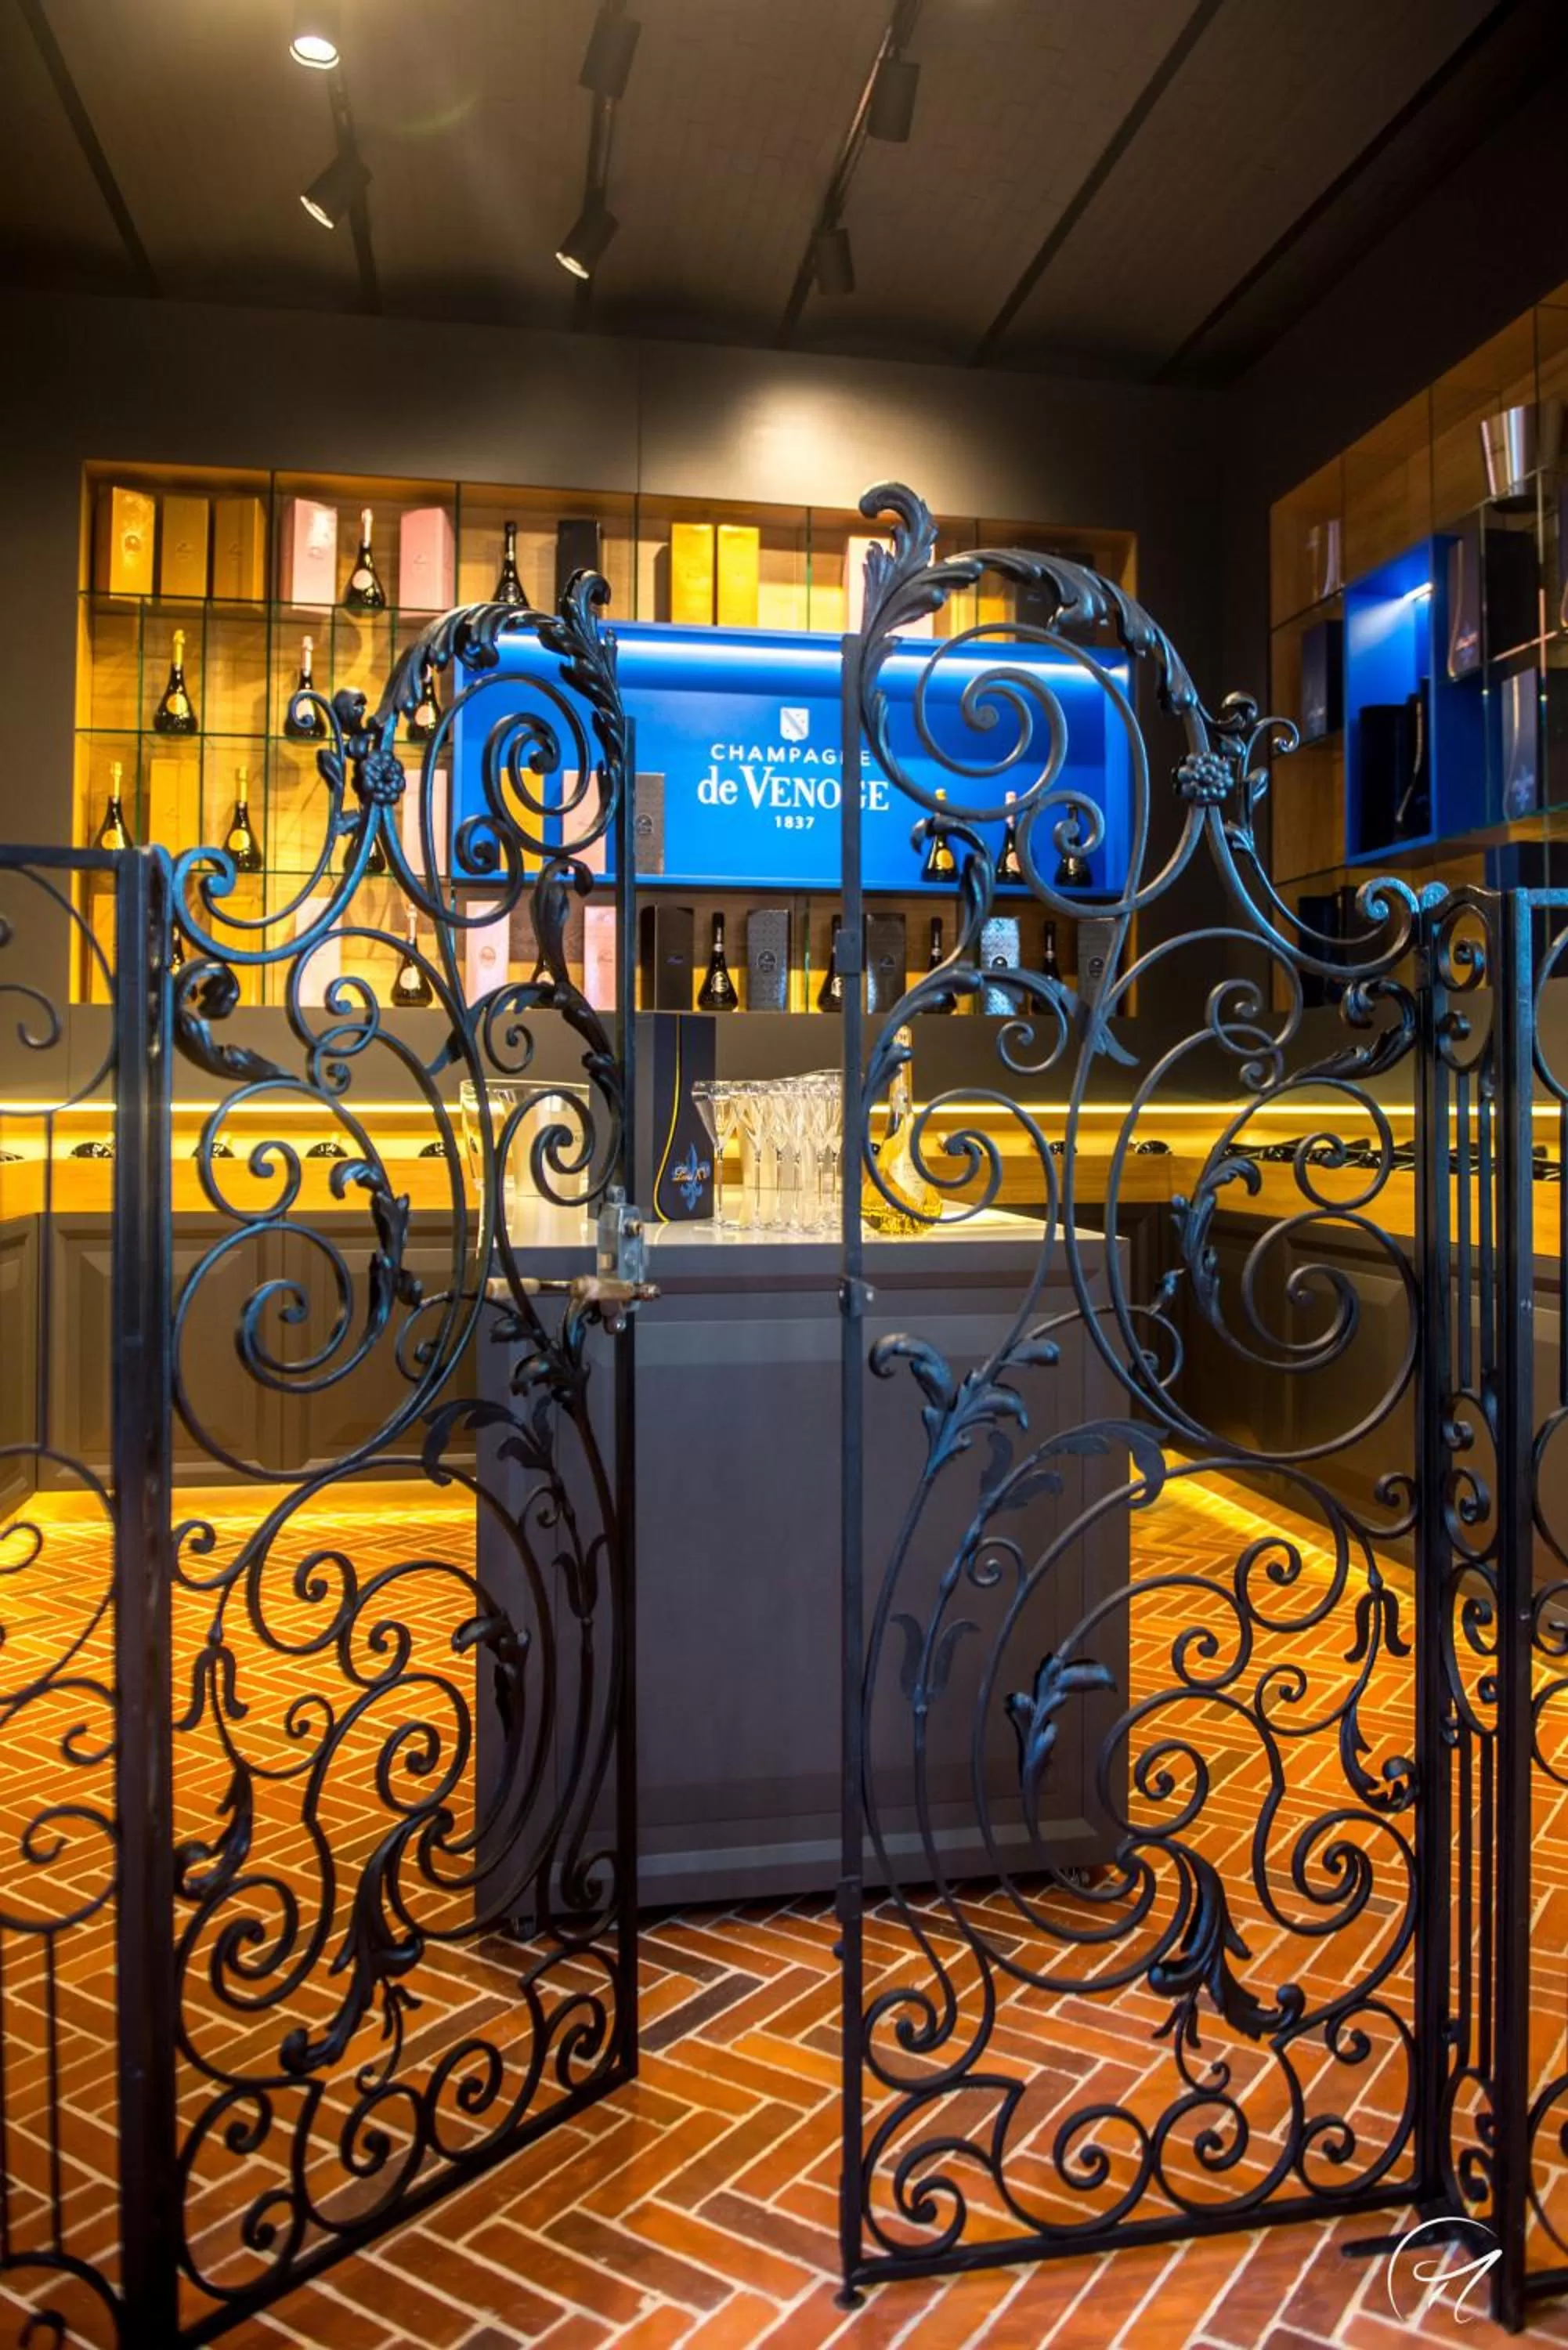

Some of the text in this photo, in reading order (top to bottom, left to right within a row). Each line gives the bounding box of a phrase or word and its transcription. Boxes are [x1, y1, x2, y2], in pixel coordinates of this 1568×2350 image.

[710, 743, 871, 767] CHAMPAGE
[697, 765, 890, 811] de VENOE
[775, 815, 815, 830] 1837
